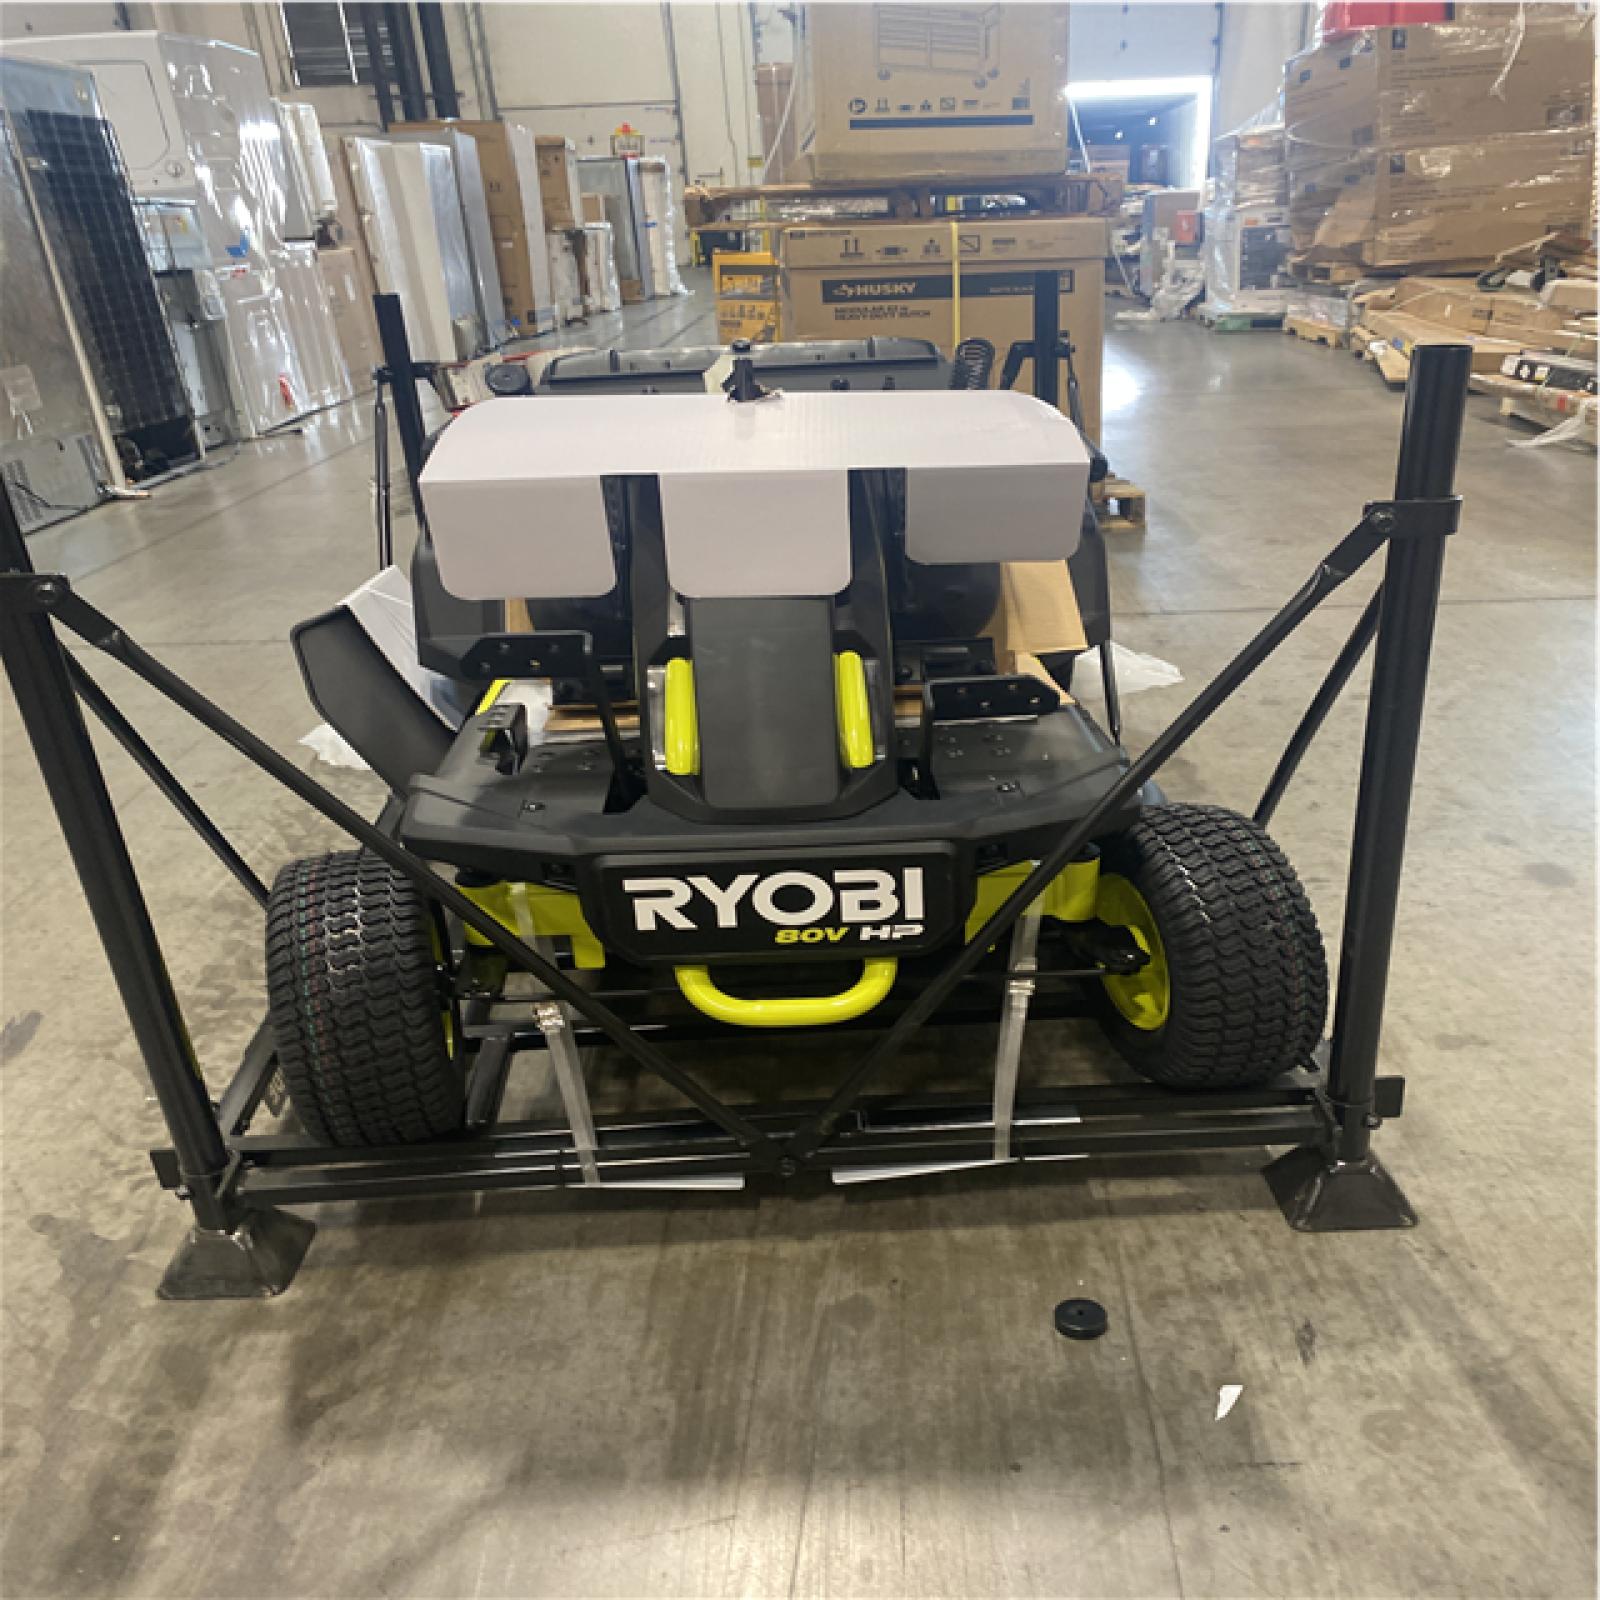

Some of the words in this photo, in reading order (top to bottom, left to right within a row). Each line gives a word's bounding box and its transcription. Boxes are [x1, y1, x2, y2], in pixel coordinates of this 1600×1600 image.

[856, 282, 916, 296] HUSKY
[622, 867, 925, 931] RYOBI
[774, 927, 849, 943] 80V
[859, 924, 925, 941] HP
